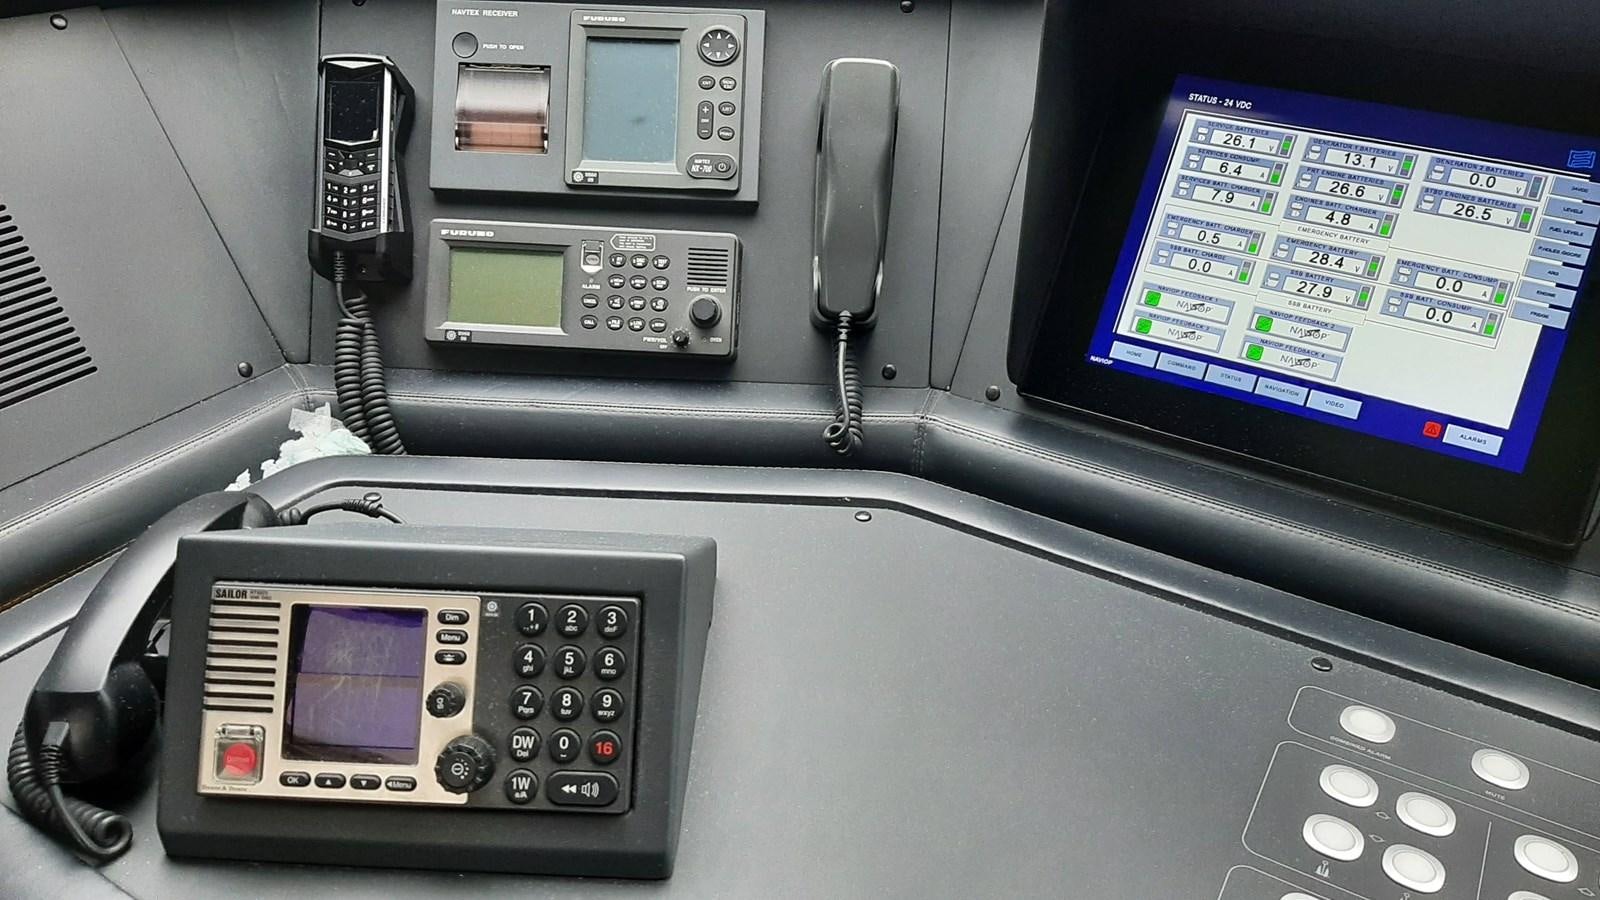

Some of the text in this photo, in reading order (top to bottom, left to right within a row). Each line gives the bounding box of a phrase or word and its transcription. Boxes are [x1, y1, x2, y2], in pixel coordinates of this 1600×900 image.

[1188, 93, 1218, 104] STATUS
[1224, 99, 1234, 107] 24
[1236, 100, 1252, 109] VDC
[1208, 121, 1269, 135] SERVICE BATTERIES
[1222, 134, 1256, 148] 26.1
[1314, 138, 1352, 149] GENERATOR
[1360, 146, 1396, 157] BATTERIES
[1198, 149, 1228, 158] SERVICES
[1344, 152, 1376, 168] 13.1
[1220, 162, 1242, 176] 6.4
[1436, 158, 1477, 169] GENERATOR
[1485, 166, 1524, 177] BATTERIES
[1321, 169, 1345, 178] ENGINE
[1348, 173, 1384, 185] BATTERIES
[1469, 173, 1496, 188] 0.0
[1181, 175, 1210, 184] SERVICES
[1231, 184, 1260, 193] CHARGER
[1329, 181, 1365, 198] 26.6
[1211, 189, 1234, 203] 7.9
[1445, 191, 1475, 201] ENGINES
[1477, 195, 1517, 208] BATTERIES
[1295, 196, 1324, 206] ENGINES
[1345, 204, 1377, 215] CHARGER
[1453, 203, 1492, 220] 26.5
[1167, 214, 1203, 224] EMERGENCY
[1224, 225, 1253, 235] CHARGER
[1325, 211, 1351, 225] 4.8
[1198, 230, 1221, 244] 0.5
[1298, 226, 1369, 244] EMERGENCY BATTERY
[1287, 237, 1359, 256] EMERGENCY BATTERY
[1201, 251, 1226, 260] CHARGE
[1309, 252, 1344, 268] 28.4
[1188, 259, 1212, 272] 0.0
[1397, 259, 1439, 272] EMERGENCY
[1305, 272, 1335, 283] BATTERY
[1436, 276, 1463, 292] 0.0
[1181, 290, 1213, 300] FEEDBACK
[1297, 281, 1332, 298] 27.9
[1303, 304, 1332, 313] BATTERY
[1426, 307, 1452, 323] 0.0
[1172, 318, 1204, 328] FEEDBACK
[1270, 310, 1293, 318] NAVIOP
[1295, 316, 1328, 327] FEEDBACK
[1126, 350, 1142, 358] HOME
[1285, 345, 1318, 356] FEEDBACK
[1090, 356, 1113, 365] NAVIOP
[1168, 360, 1196, 370] COMMAND
[1220, 373, 1241, 382] STATUS
[1265, 384, 1299, 396] NAVIGATION
[1325, 400, 1344, 409] VIDEO
[1460, 434, 1487, 445] ALARMS
[216, 589, 248, 599] SAILOR
[528, 609, 534, 621] 1
[567, 610, 577, 623] 2
[607, 611, 616, 624] 3
[524, 650, 533, 663] 4
[565, 652, 574, 665] 5
[605, 653, 614, 666] 6
[522, 665, 533, 673] ghi
[522, 692, 532, 705] 7
[562, 694, 572, 706] 8
[602, 695, 612, 708] 9
[512, 736, 535, 749] DW
[560, 736, 569, 749] 0
[596, 742, 613, 755] 16
[512, 777, 531, 790] 1W
[1485, 790, 1505, 800] MUTE
